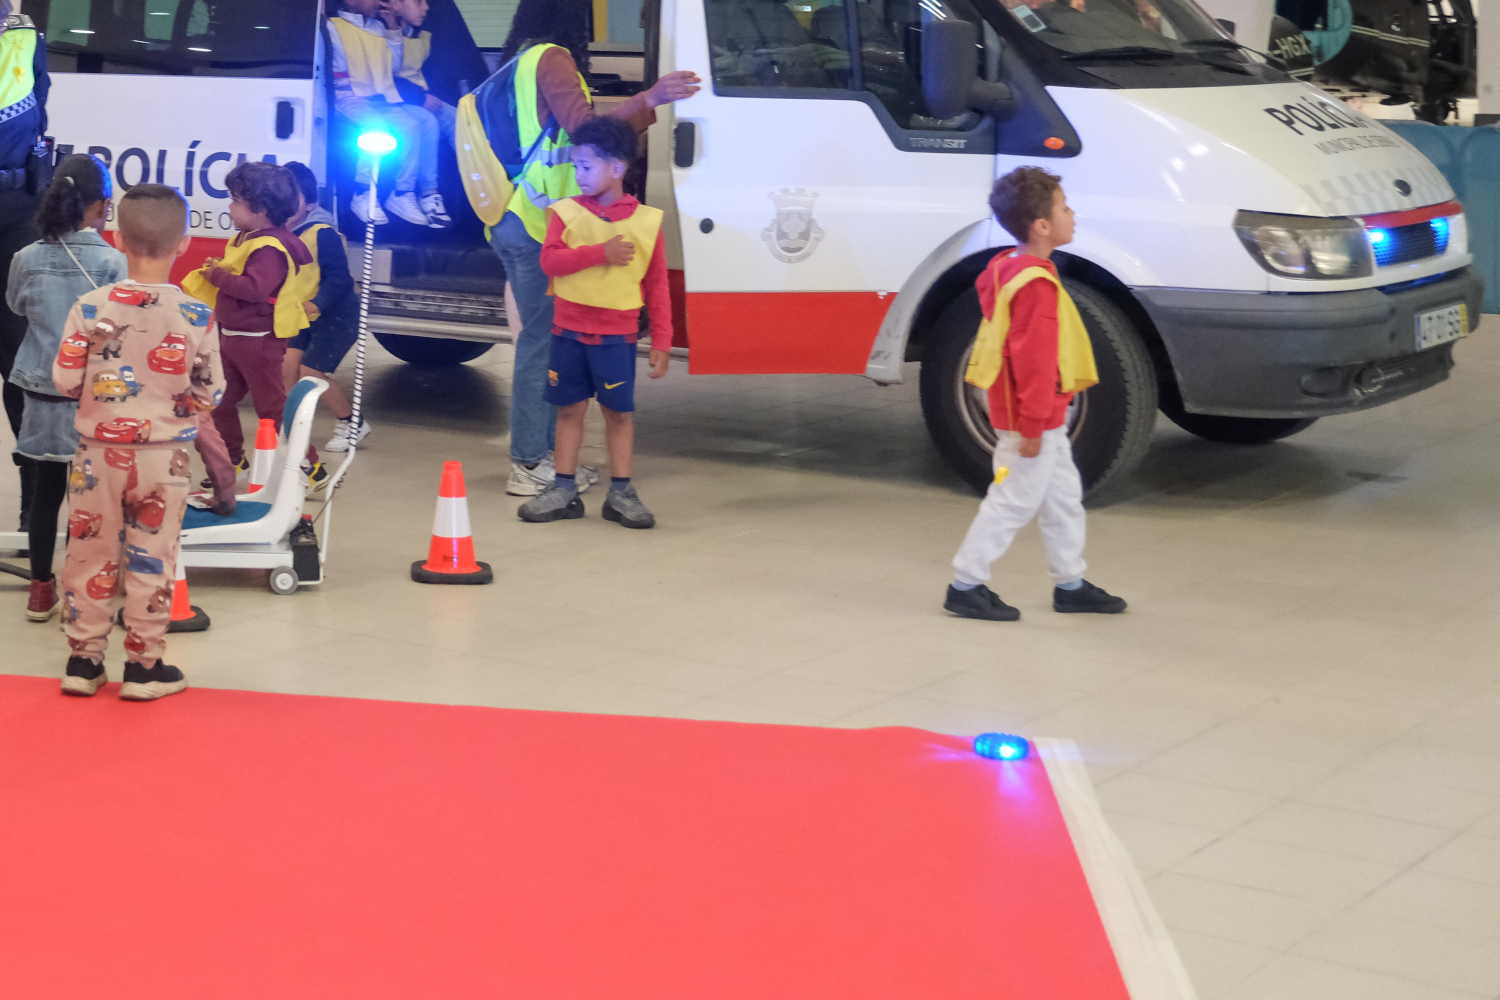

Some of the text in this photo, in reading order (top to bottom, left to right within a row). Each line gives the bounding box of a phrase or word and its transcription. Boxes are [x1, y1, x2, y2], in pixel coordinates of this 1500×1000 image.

[1263, 96, 1370, 136] POLÍCIA
[87, 140, 277, 200] POLÍC
[190, 210, 213, 230] DE
